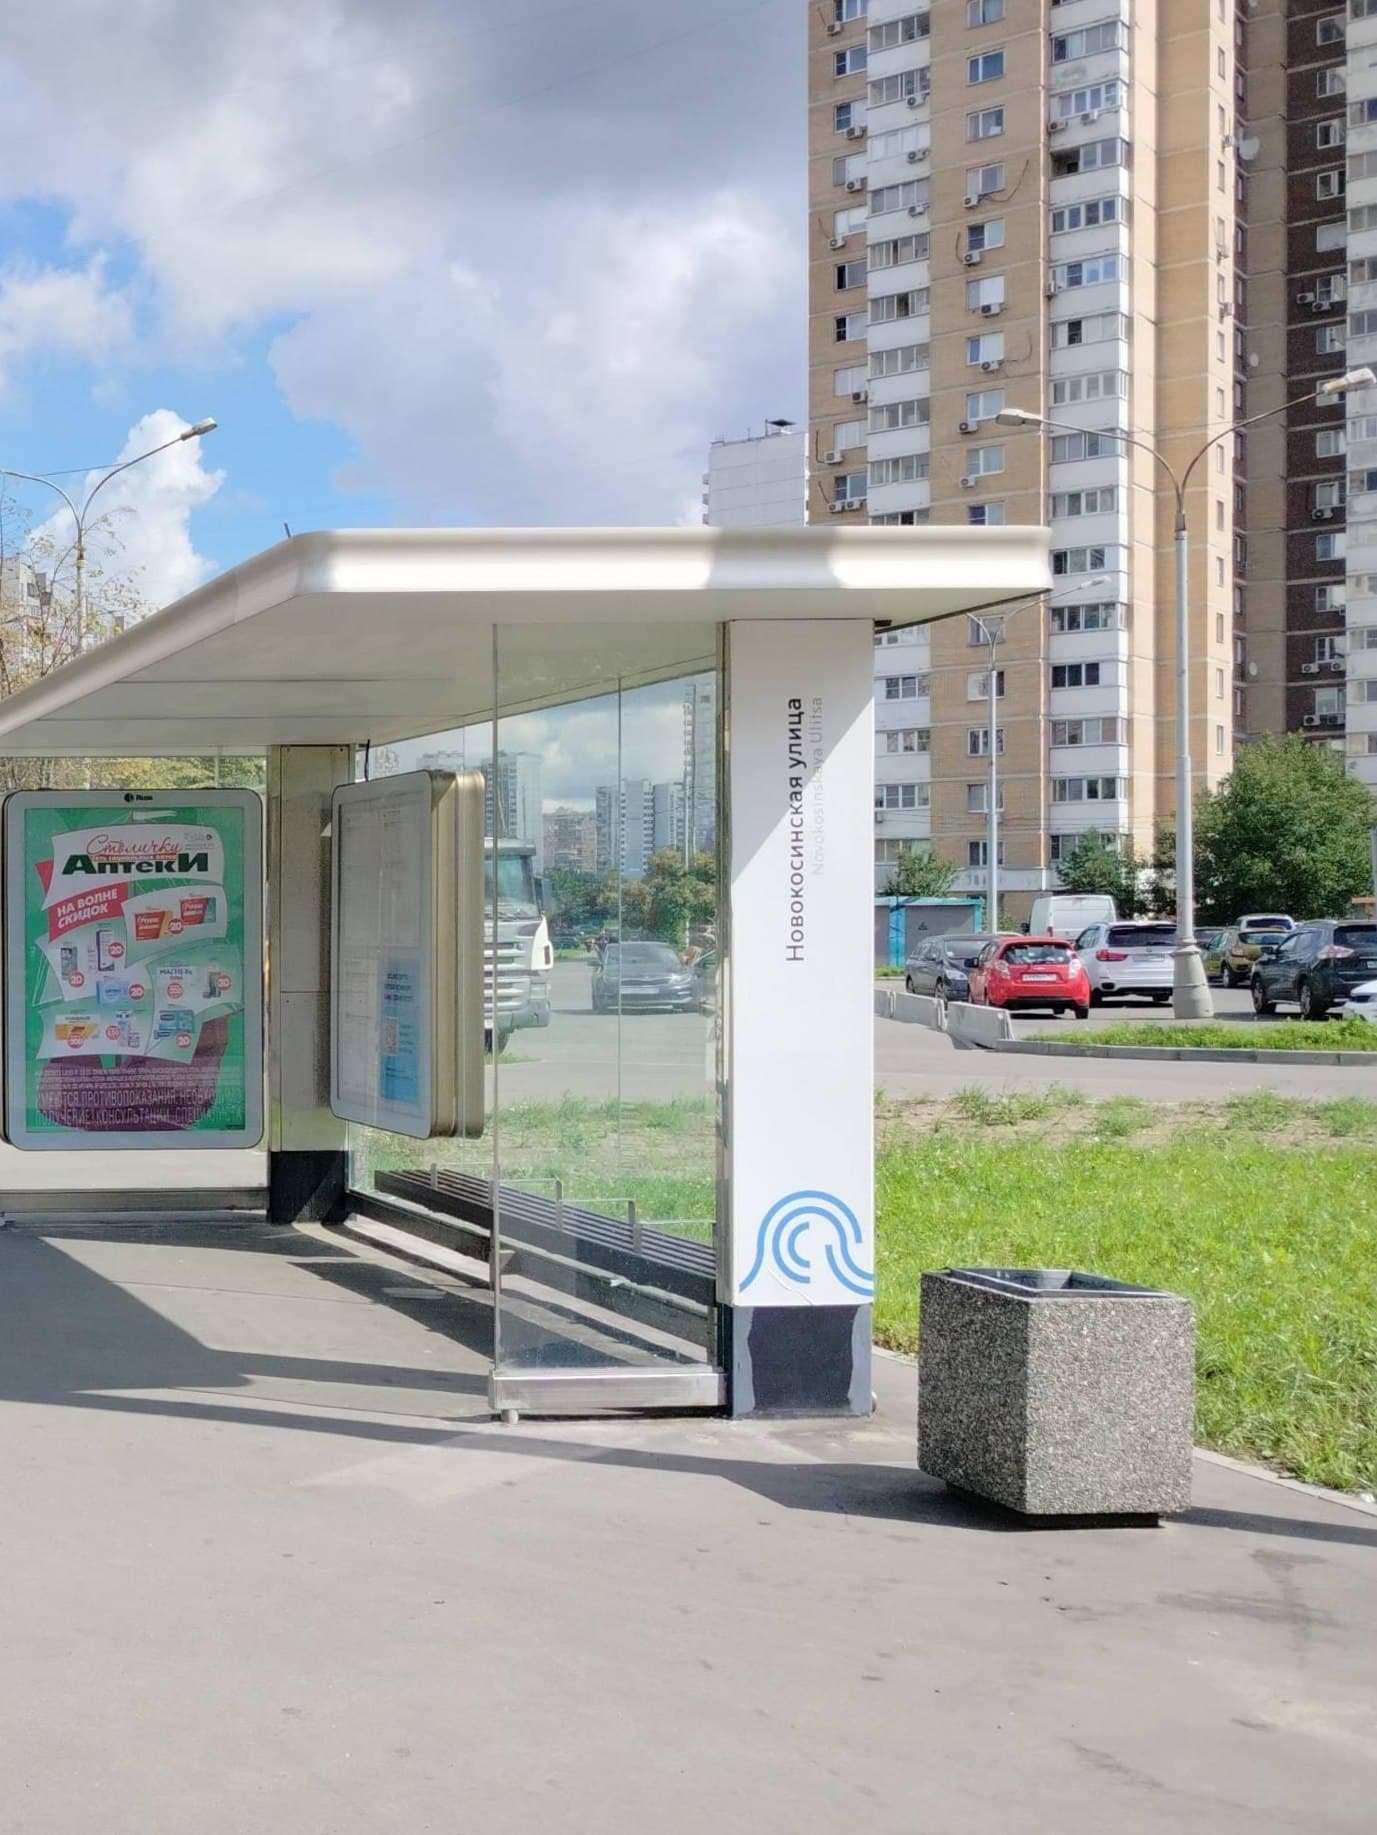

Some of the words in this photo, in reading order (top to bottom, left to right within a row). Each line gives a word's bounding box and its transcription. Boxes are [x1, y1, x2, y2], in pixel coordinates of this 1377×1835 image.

[787, 698, 807, 769] улица
[785, 776, 805, 961] Новокосинская
[57, 904, 76, 918] НА
[77, 888, 118, 909] ВОЛНЕ
[58, 902, 109, 929] СКИДОК
